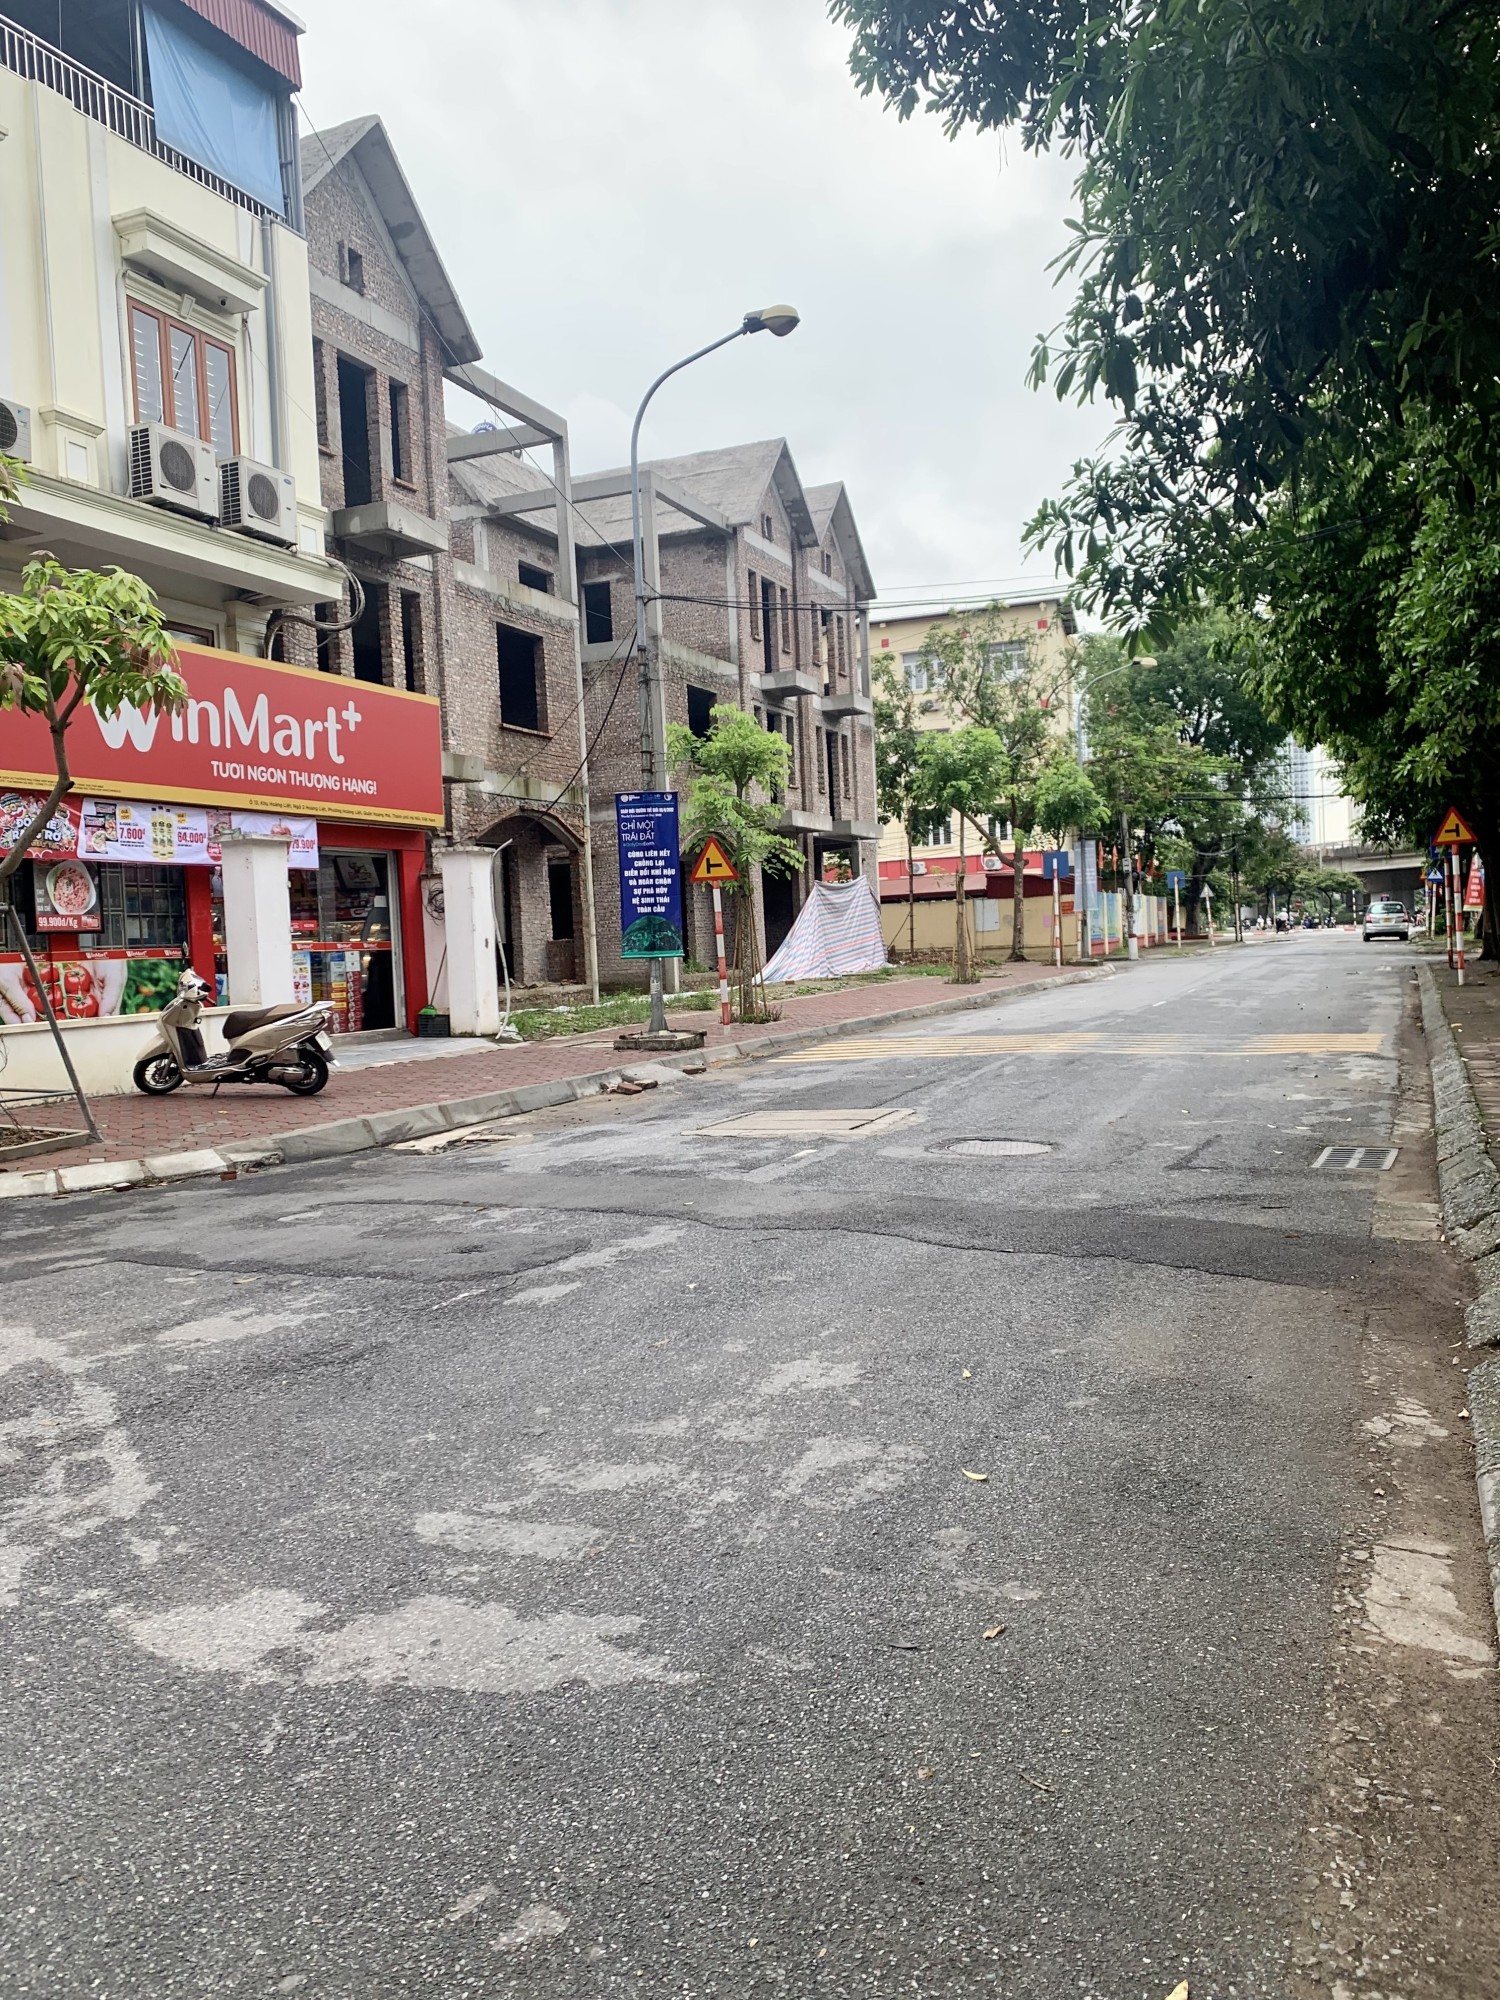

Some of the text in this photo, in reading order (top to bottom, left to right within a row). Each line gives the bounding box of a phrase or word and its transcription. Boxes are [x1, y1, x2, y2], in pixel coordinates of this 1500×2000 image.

[211, 760, 378, 796] TƯƠI NGON THƯỢNG HẠNG!
[621, 819, 654, 830] CHỈ MỘT
[622, 830, 654, 841] TRÁI ĐẤT
[655, 859, 665, 867] LẠI
